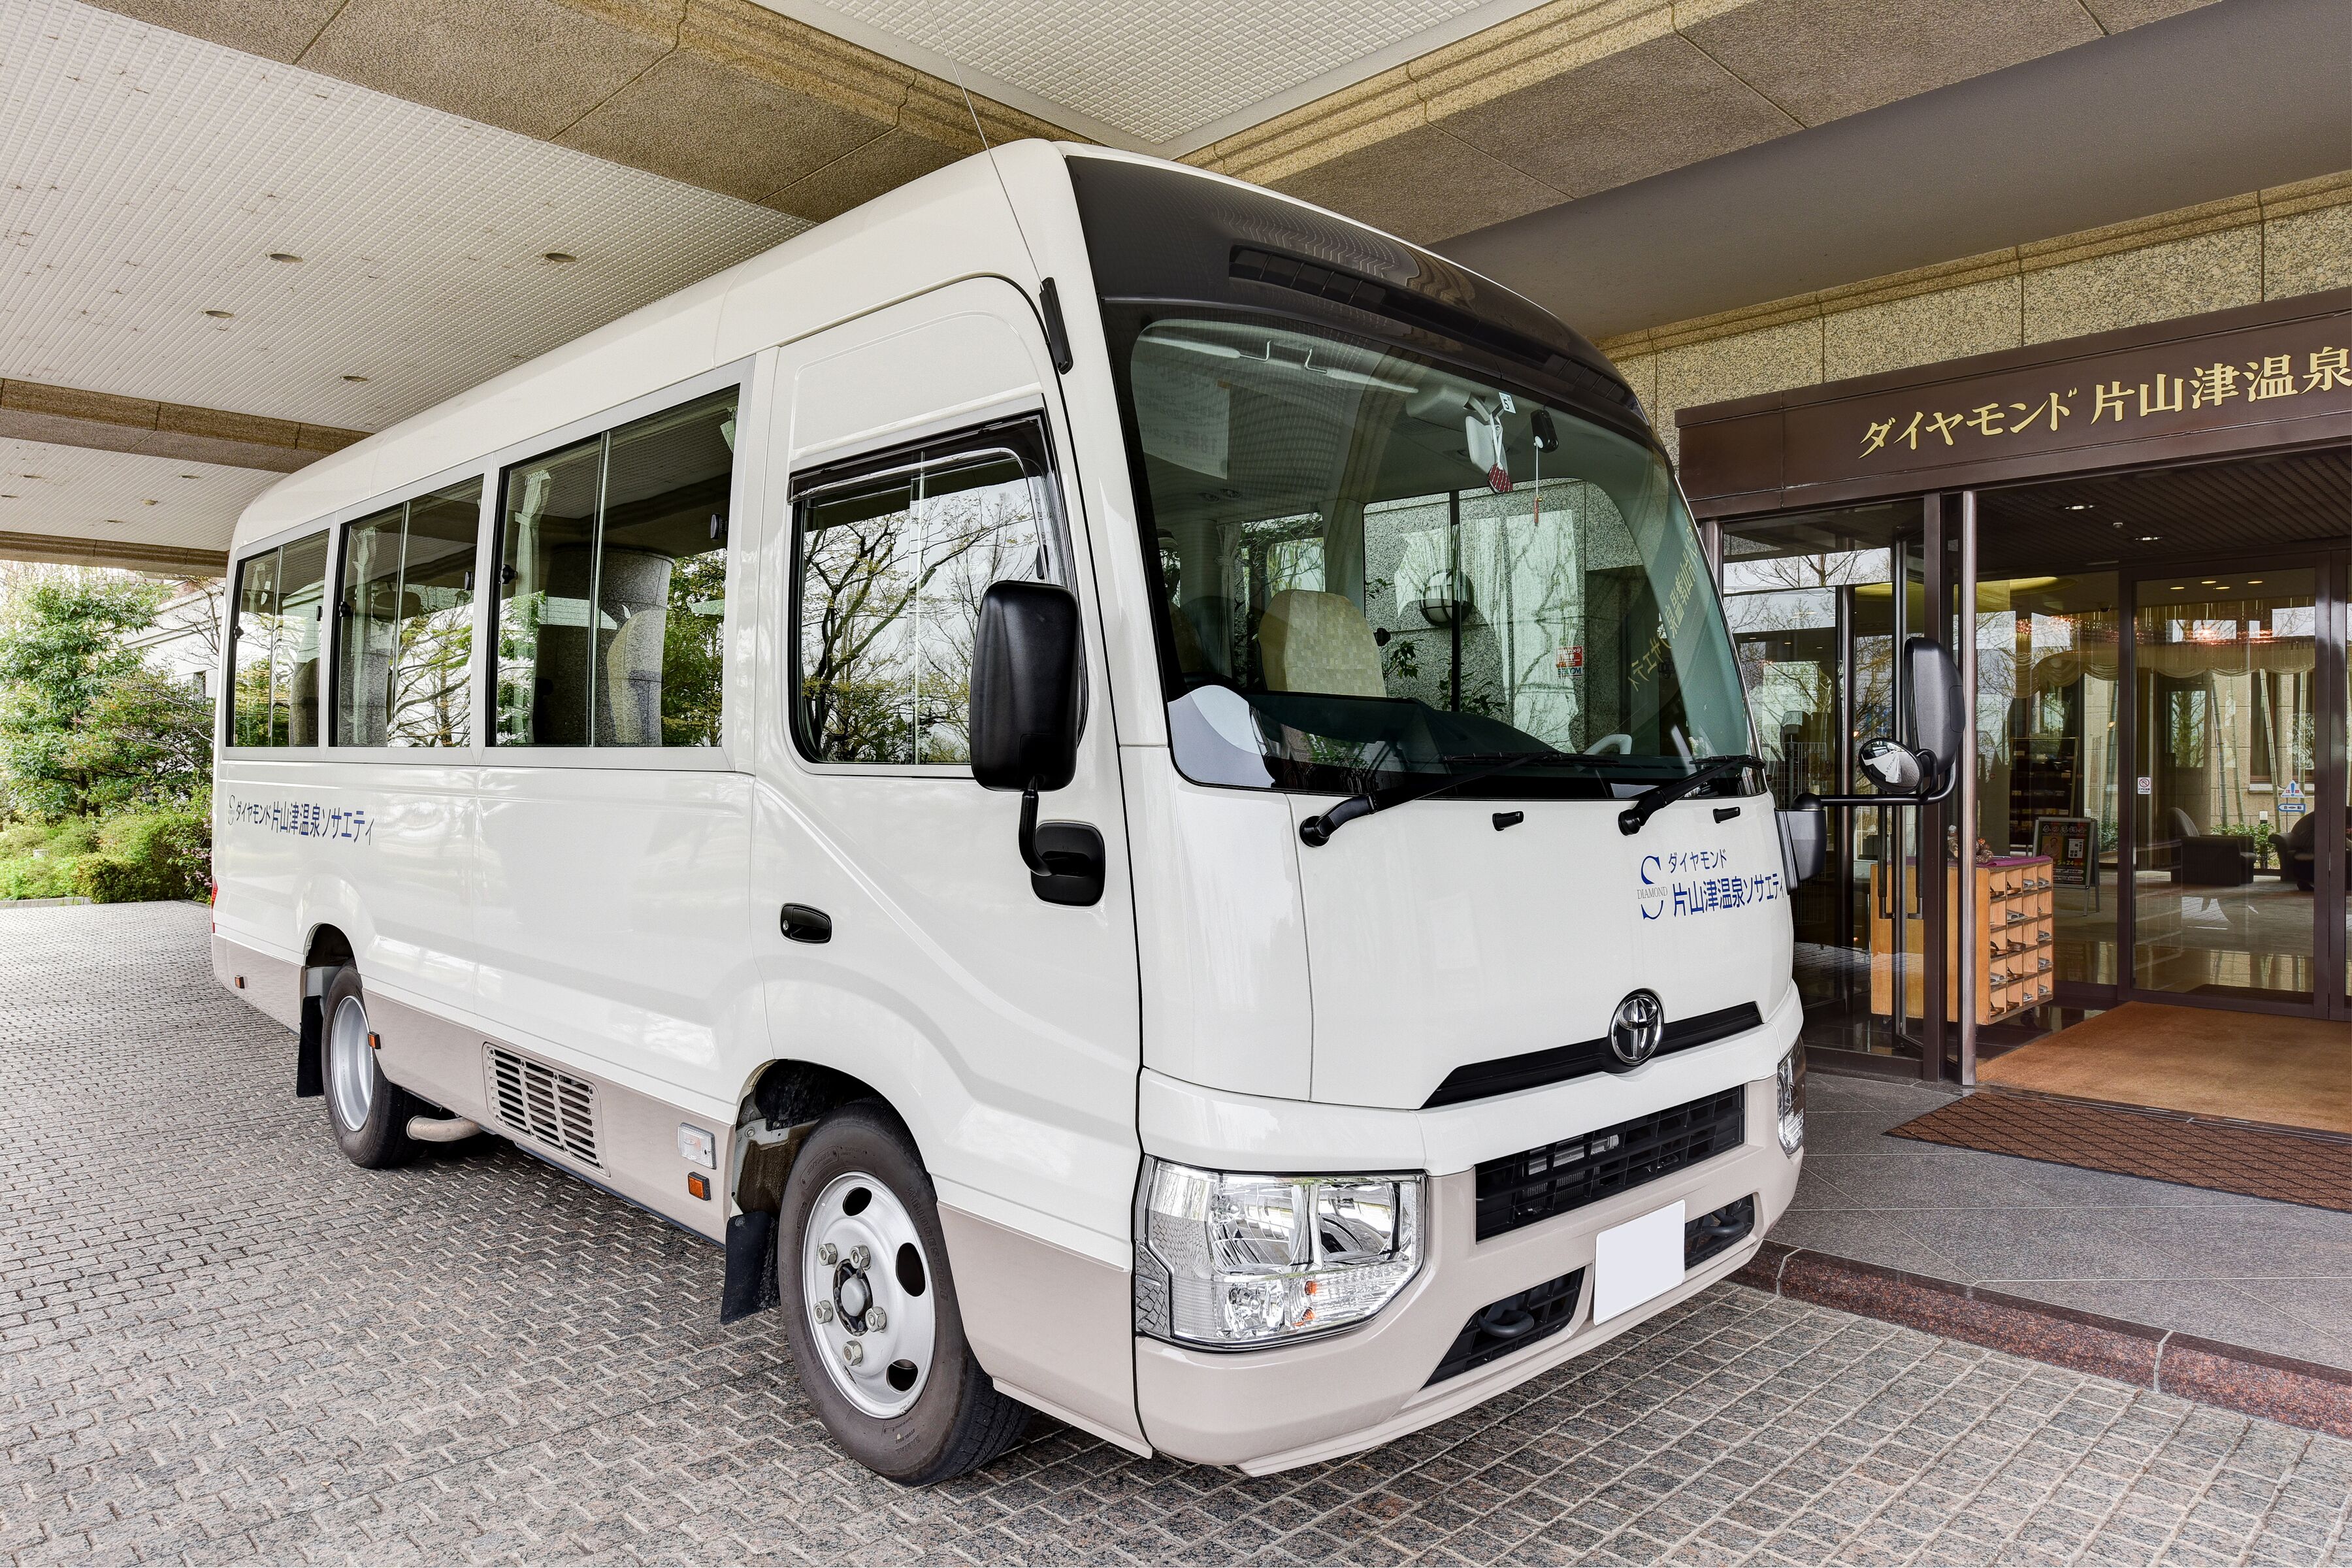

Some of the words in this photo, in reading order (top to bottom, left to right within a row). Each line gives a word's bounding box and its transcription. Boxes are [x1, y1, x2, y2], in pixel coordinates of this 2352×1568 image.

[1859, 387, 2078, 459] ダイヤモンド
[2091, 346, 2352, 425] 片山津温泉
[1668, 849, 1727, 874] ダイヤモンド
[1637, 886, 1668, 900] DIAMOND
[1673, 873, 1785, 917] 片山津温泉ソサエティ
